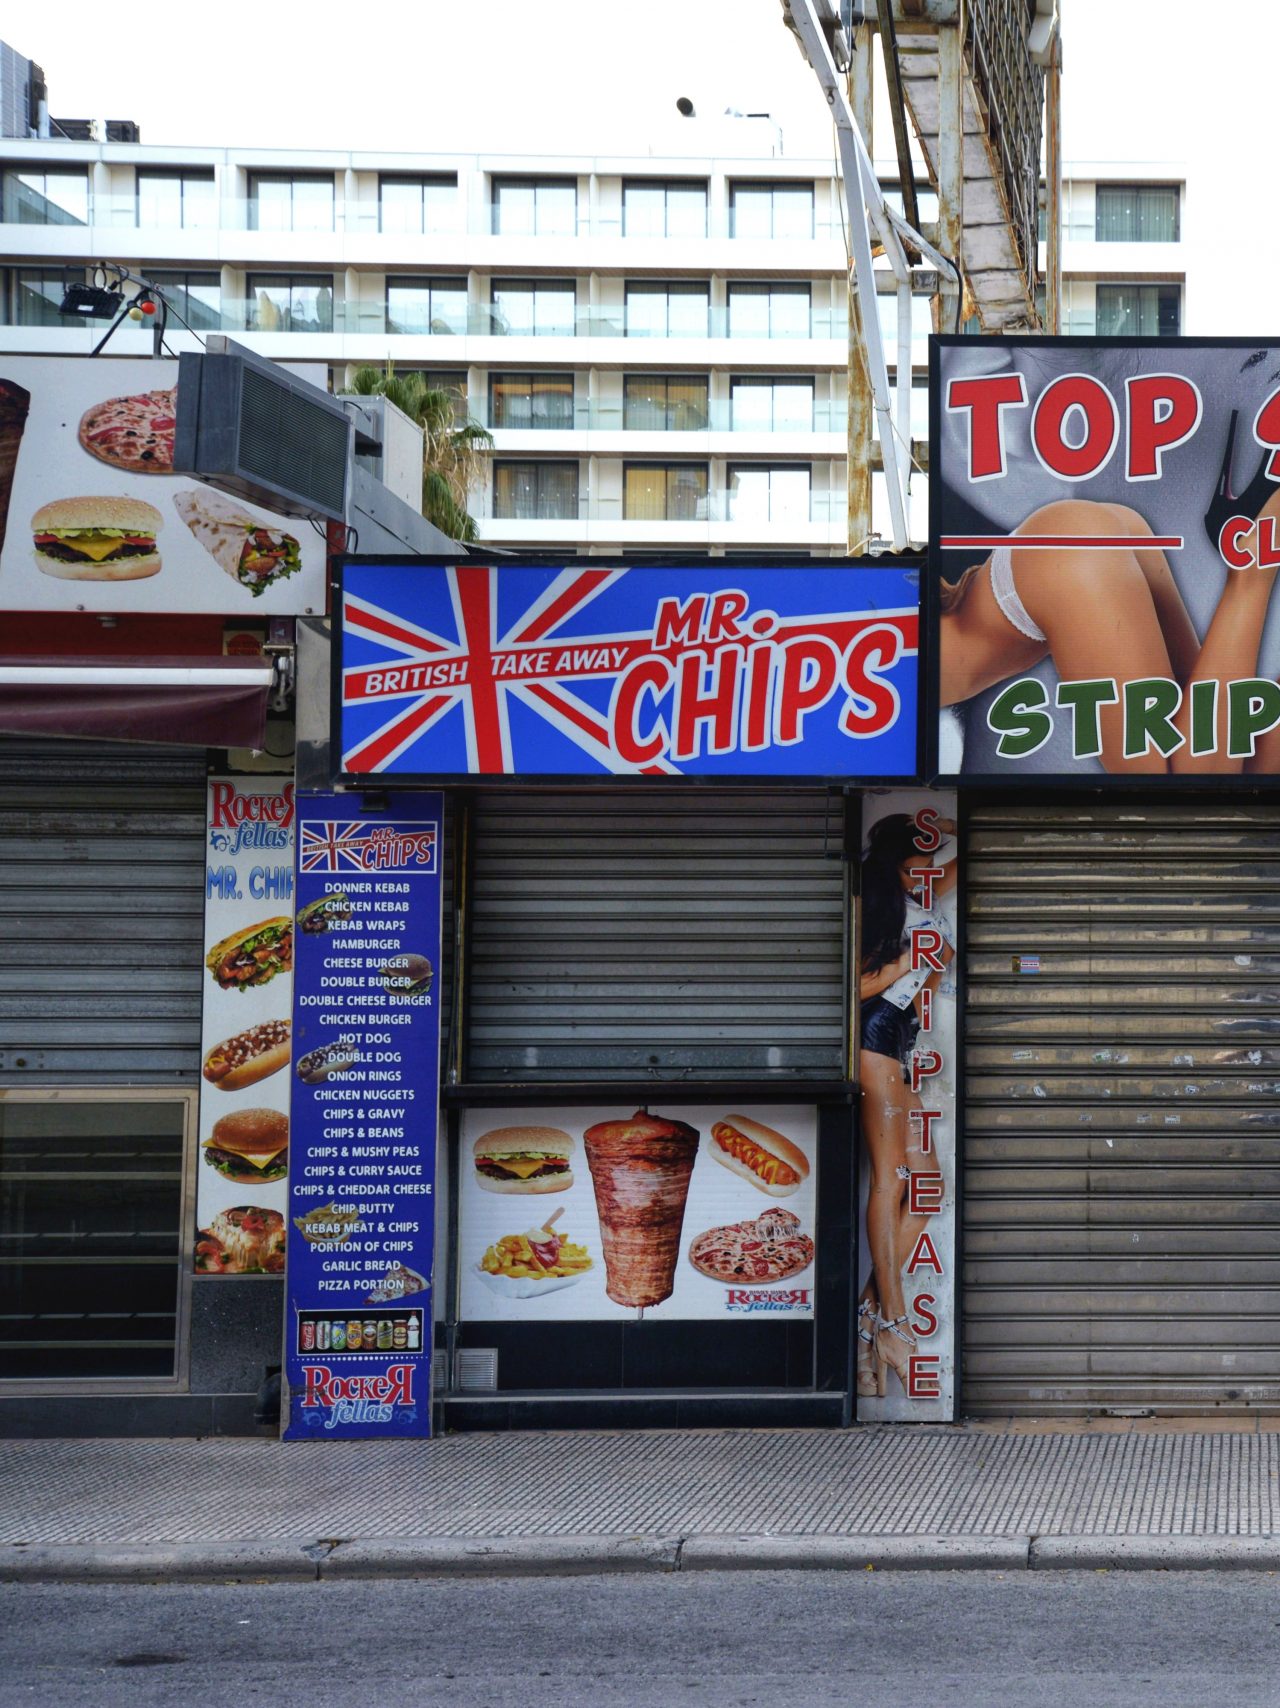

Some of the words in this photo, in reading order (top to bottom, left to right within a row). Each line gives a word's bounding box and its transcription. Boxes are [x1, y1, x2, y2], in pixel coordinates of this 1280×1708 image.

[945, 372, 1203, 483] TOP
[651, 588, 781, 651] MR.
[364, 661, 467, 694] BRITISH
[491, 652, 549, 675] TAKE
[556, 647, 629, 671] AWAY
[608, 623, 904, 763] CHIPS
[230, 820, 288, 855] fellas
[371, 827, 400, 841] MR.
[361, 836, 431, 870] CHIPS
[207, 866, 242, 900] MR.
[325, 883, 372, 893] DONNER
[375, 883, 410, 893] KEBAB
[325, 902, 371, 912] CHICKEN
[375, 902, 409, 912] KEBAB
[328, 921, 363, 931] KEBAB
[366, 921, 405, 931] WRAPS
[333, 939, 400, 949] HAMBURGER
[324, 958, 362, 968] CHEESE
[366, 958, 409, 968] BURGER
[321, 977, 365, 987] DOUBLE
[368, 977, 411, 987] BURGER
[300, 996, 344, 1006] DOUBLE
[347, 996, 386, 1006] CHEESE
[389, 995, 431, 1006] BURGER
[319, 1015, 366, 1025] CHICKEN
[369, 1015, 411, 1025] BURGER
[339, 1033, 363, 1043] HOT
[367, 1033, 391, 1043] DOG
[328, 1052, 373, 1062] DOUBLE
[376, 1052, 401, 1062] DOG
[328, 1071, 365, 1081] ONION
[368, 1071, 401, 1081] RINGS
[314, 1090, 360, 1100] CHICKEN
[364, 1090, 415, 1100] NUGGETS
[906, 807, 947, 1401] STRIPTEASE
[323, 1109, 354, 1119] CHIPS
[358, 1109, 365, 1119] &
[368, 1109, 405, 1119] GRAVY
[323, 1128, 354, 1138] CHIPS
[358, 1128, 365, 1138] &
[368, 1128, 404, 1138] BEANS
[307, 1147, 338, 1157] CHIPS
[341, 1147, 348, 1157] &
[352, 1147, 390, 1157] MUSHY
[393, 1146, 419, 1157] PEAS
[304, 1166, 335, 1177] CHIPS
[338, 1166, 346, 1176] &
[349, 1166, 384, 1176] CURRY
[387, 1166, 422, 1176] SAUCE
[294, 1185, 324, 1196] CHIPS
[327, 1185, 335, 1195] &
[338, 1185, 390, 1195] CHEDDAR
[393, 1184, 431, 1195] CHEESE
[331, 1204, 355, 1214] CHIP
[359, 1204, 394, 1214] BUTTY
[305, 1223, 340, 1233] KEBAB
[343, 1223, 374, 1233] MEAT
[377, 1223, 385, 1233] &
[388, 1222, 419, 1233] CHIPS
[310, 1242, 361, 1253] PORTION
[364, 1242, 379, 1252] OF
[382, 1241, 413, 1252] CHIPS
[322, 1261, 361, 1272] GARLIC
[364, 1261, 401, 1271] BREAD
[318, 1280, 350, 1291] PIZZA
[354, 1280, 404, 1290] PORTION
[325, 1399, 392, 1428] fellas
